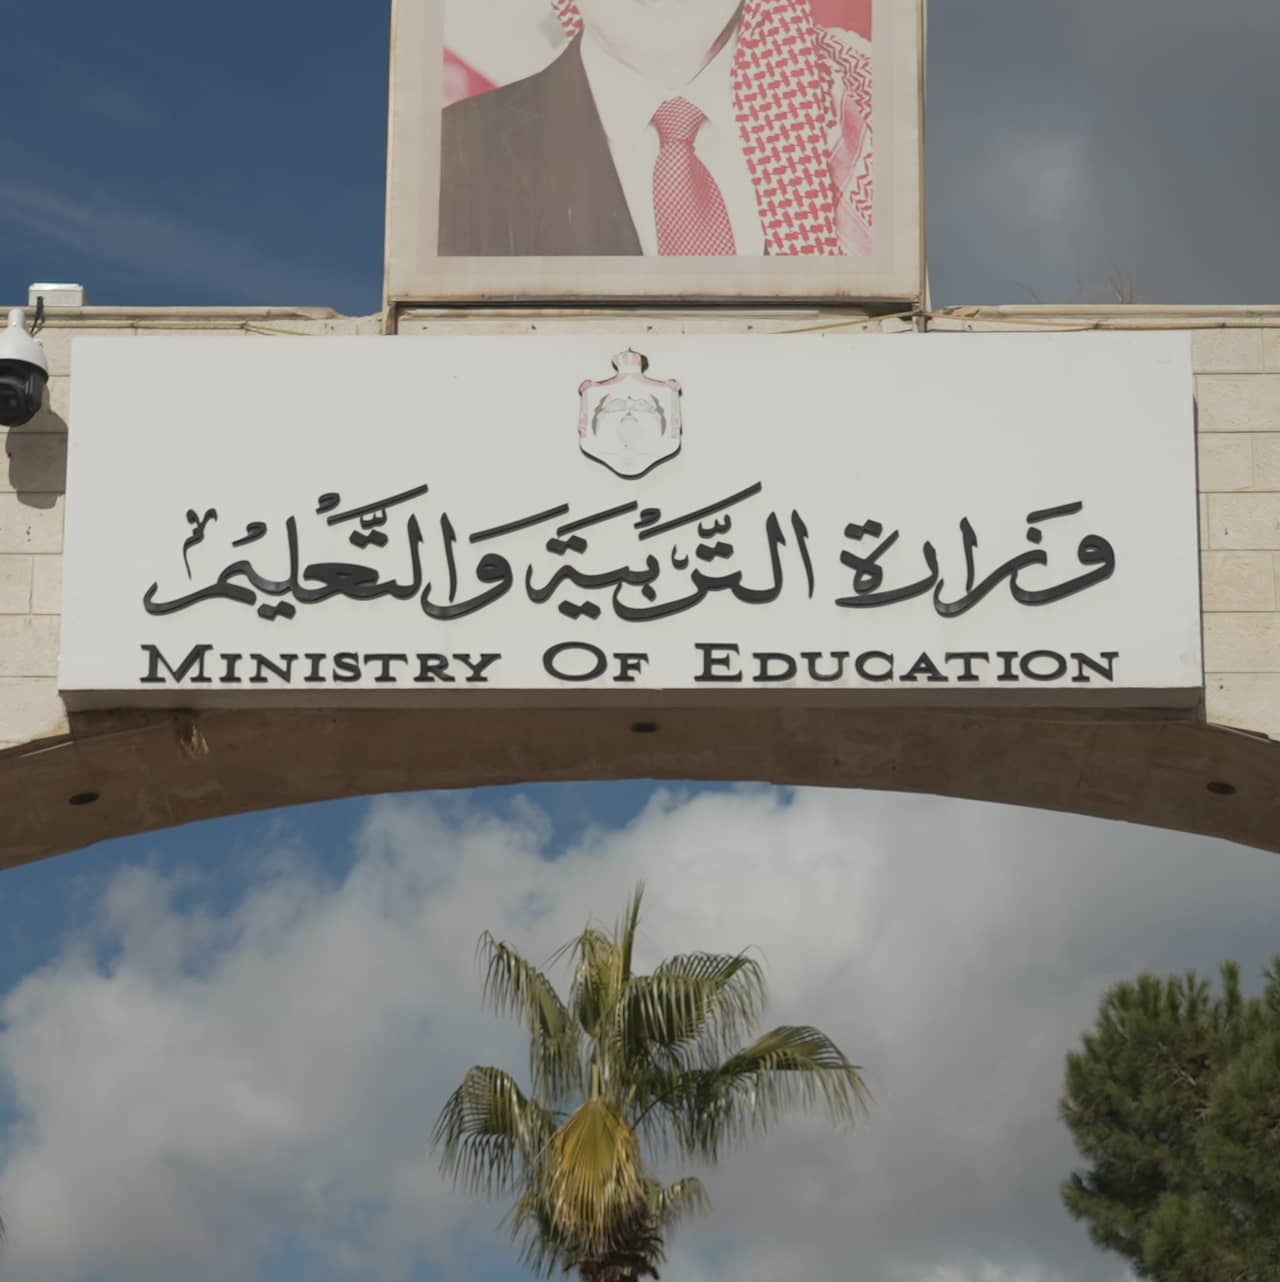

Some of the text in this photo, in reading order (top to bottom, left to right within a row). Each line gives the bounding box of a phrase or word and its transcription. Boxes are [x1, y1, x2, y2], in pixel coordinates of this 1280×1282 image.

[143, 481, 1116, 623] وزارة التربية والتعليم
[139, 641, 1119, 684] MINISTRY OF EDUCATION
